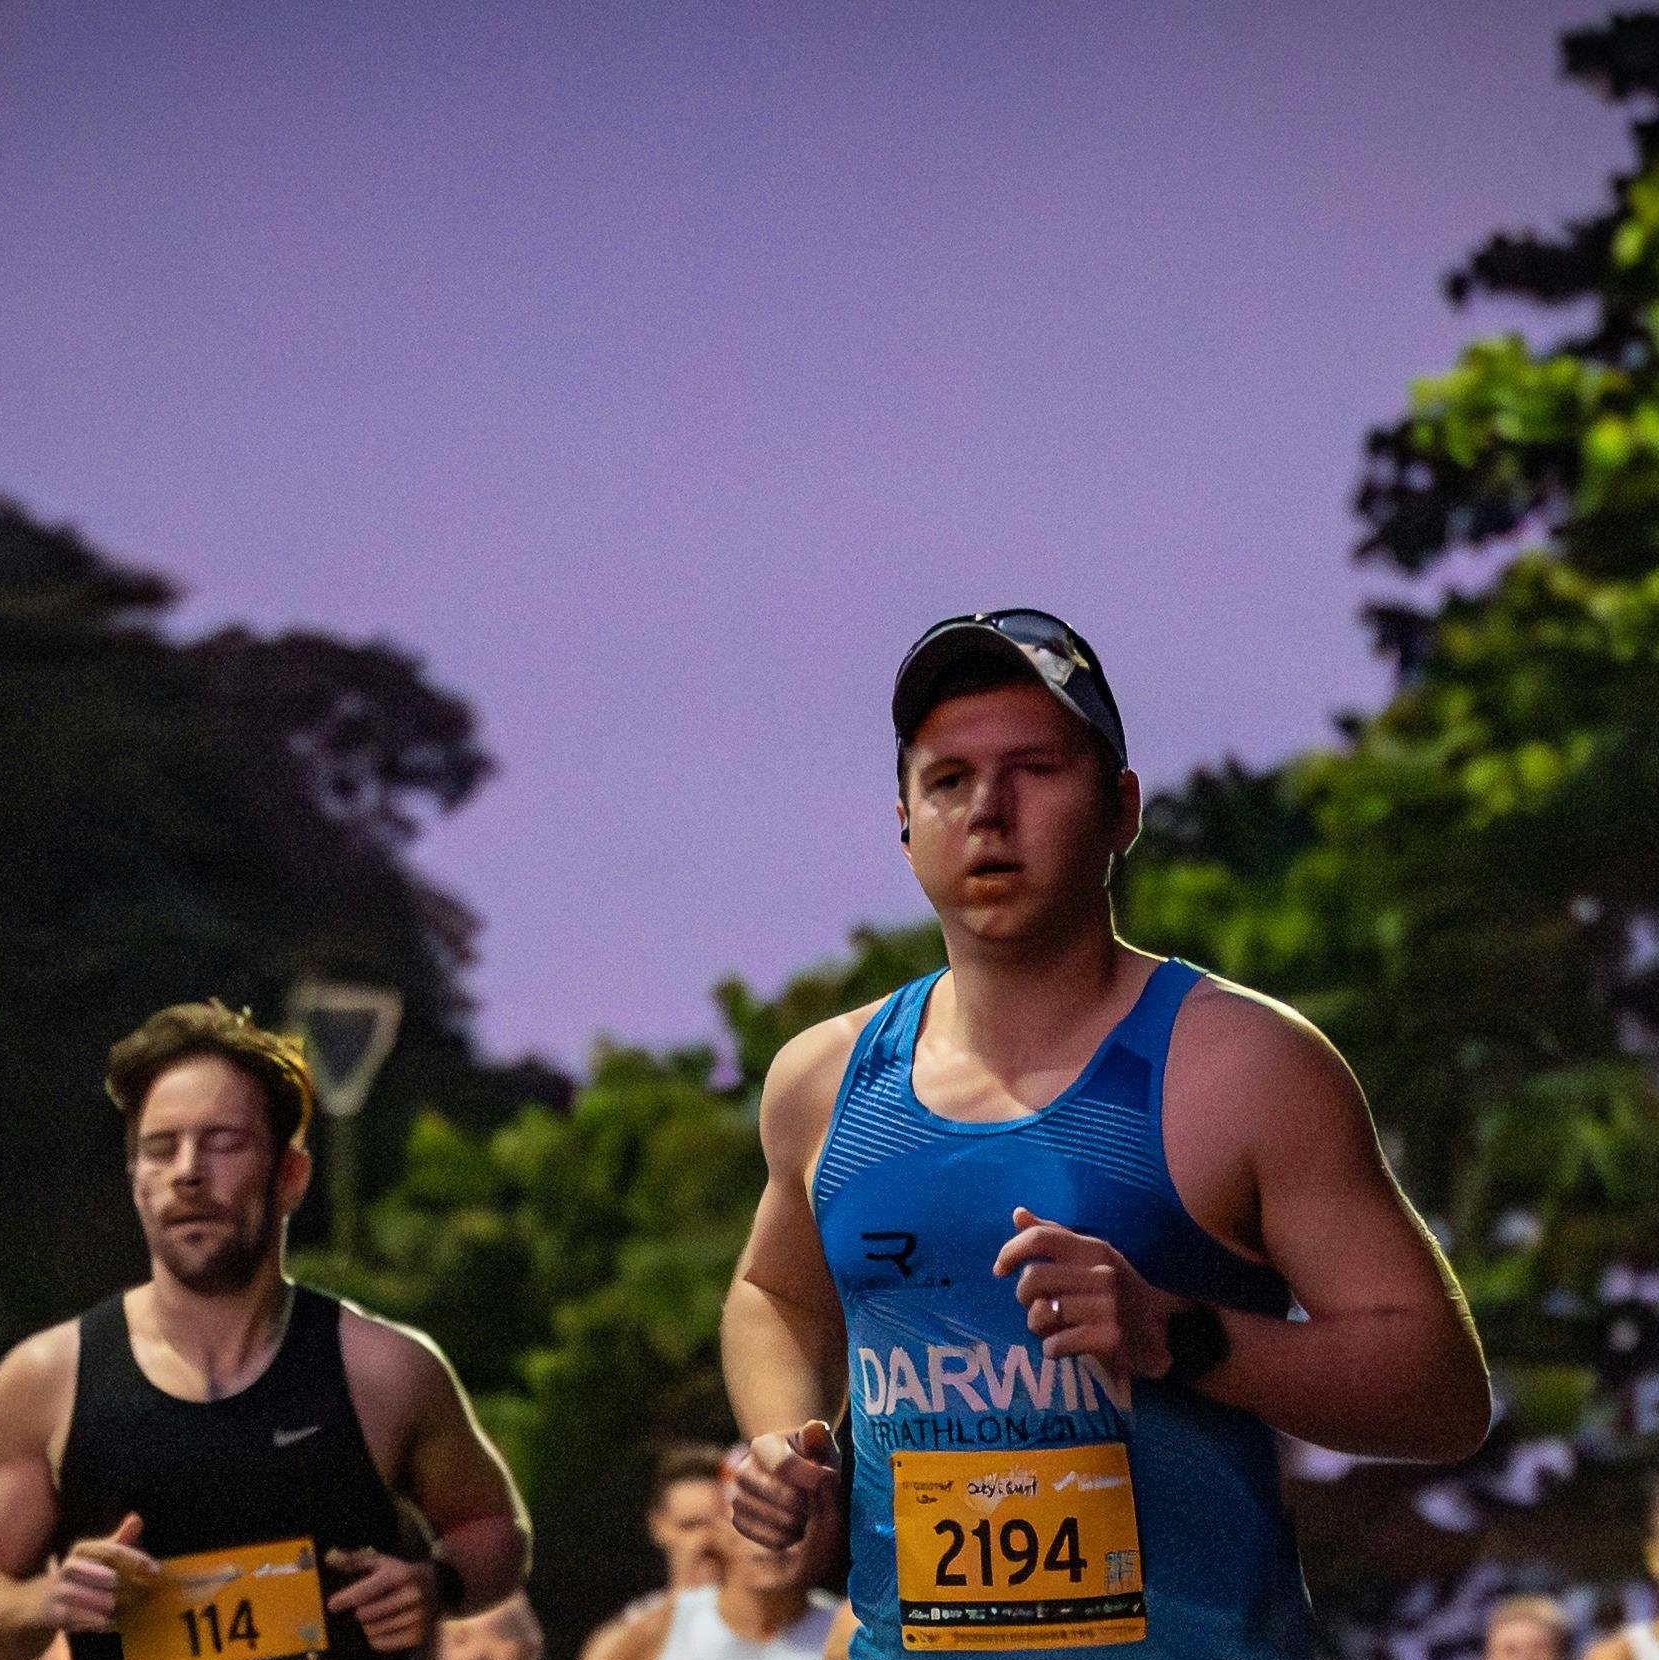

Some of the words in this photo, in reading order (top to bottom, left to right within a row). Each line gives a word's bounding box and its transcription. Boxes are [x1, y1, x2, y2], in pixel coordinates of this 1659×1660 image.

[858, 1341, 1132, 1416] DARWIN
[870, 1415, 1030, 1451] TRIATHLON
[934, 1516, 1088, 1588] 2194
[179, 1596, 260, 1657] 114
